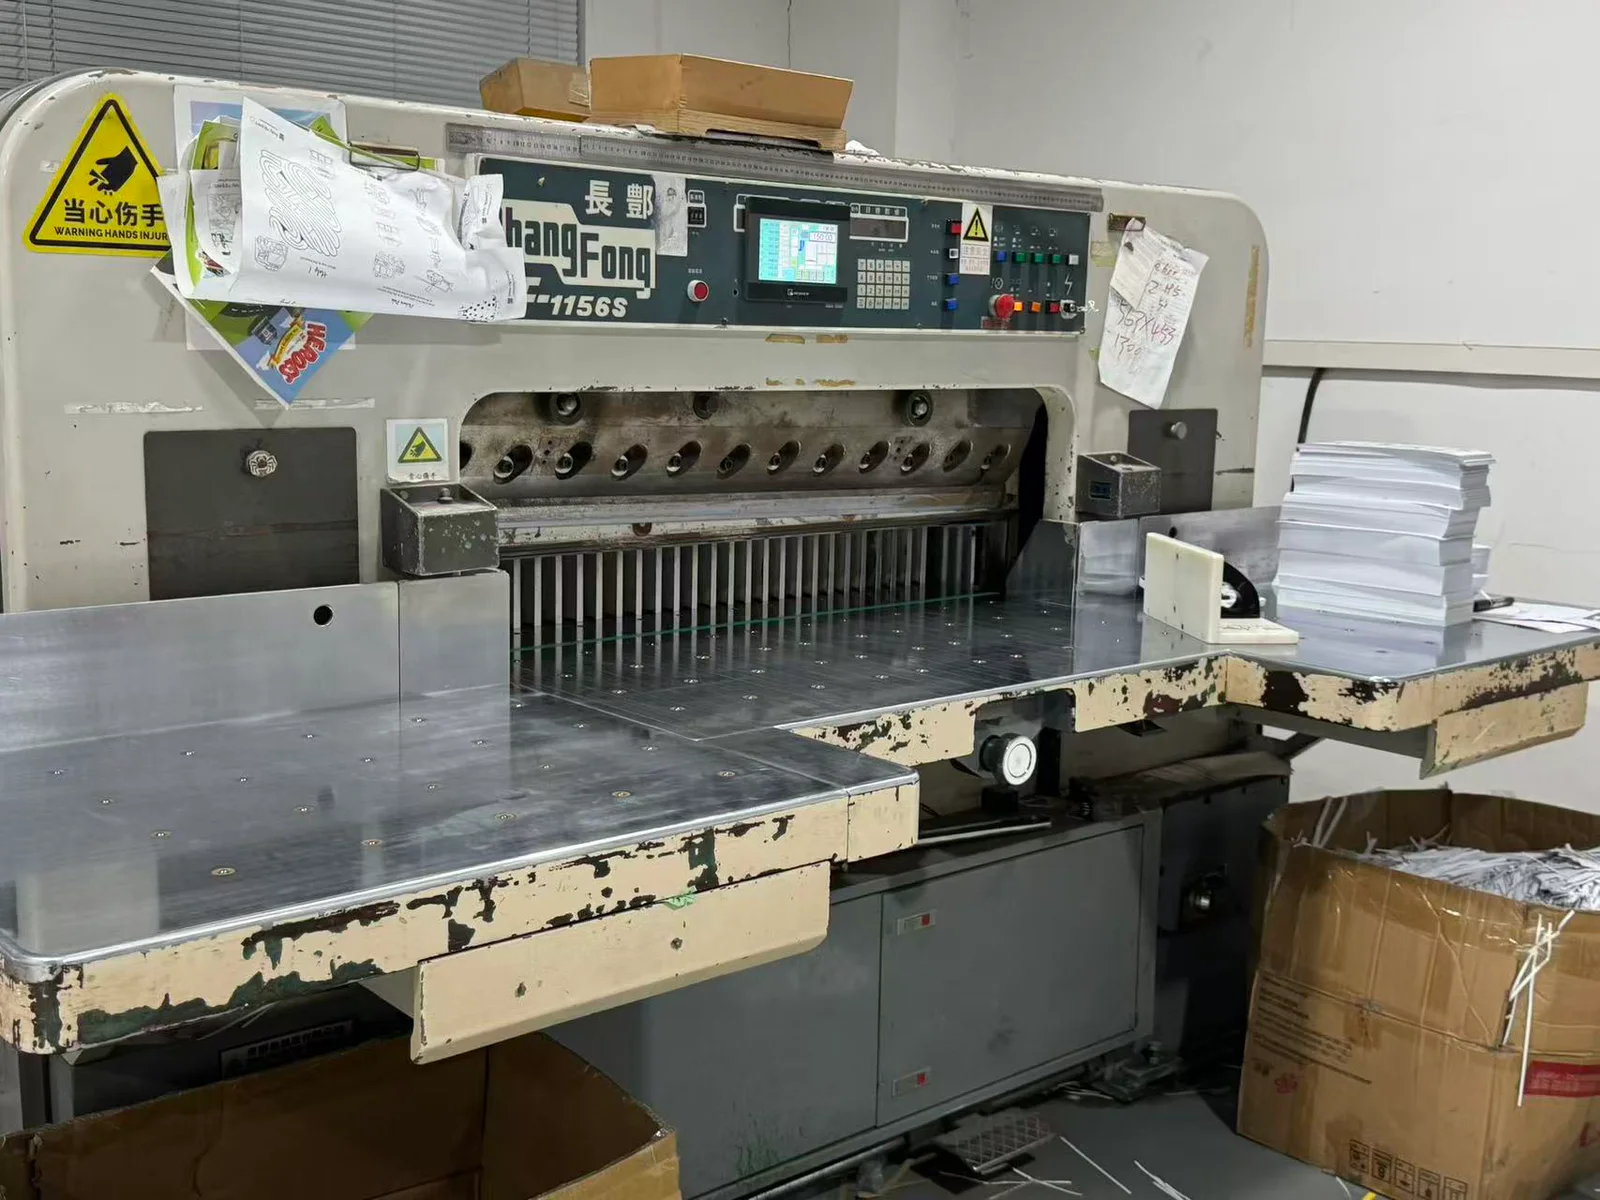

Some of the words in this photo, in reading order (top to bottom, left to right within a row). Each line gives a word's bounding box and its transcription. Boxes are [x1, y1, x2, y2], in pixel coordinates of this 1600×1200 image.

[64, 198, 164, 228] 当心伤手
[54, 226, 103, 238] WARNING
[104, 229, 138, 240] HANDS
[140, 231, 168, 241] INJUR
